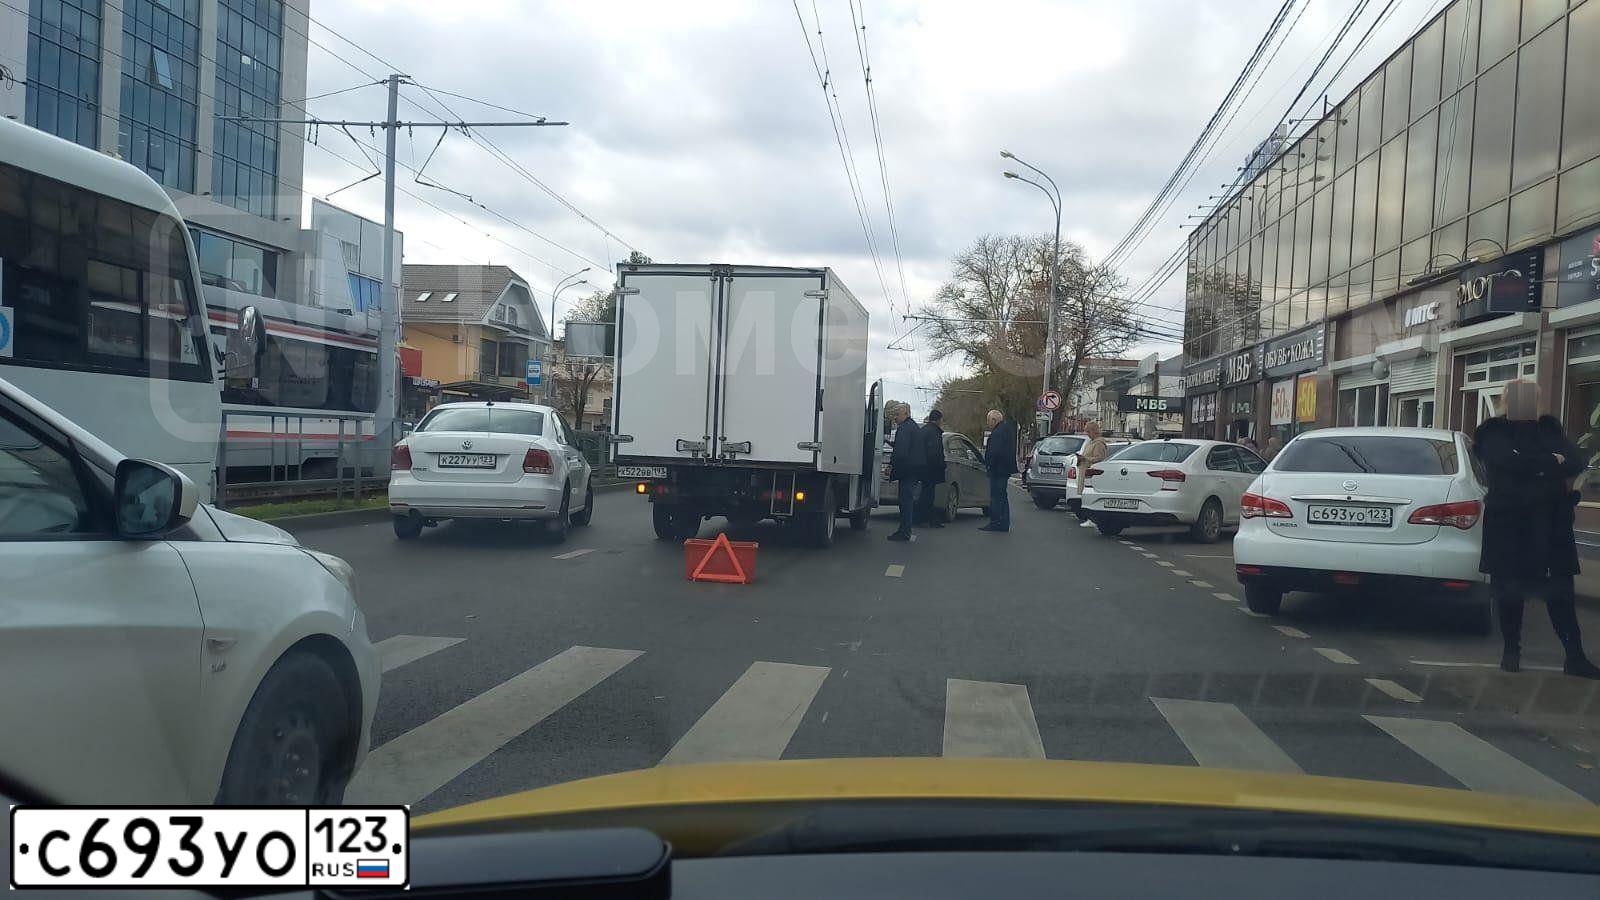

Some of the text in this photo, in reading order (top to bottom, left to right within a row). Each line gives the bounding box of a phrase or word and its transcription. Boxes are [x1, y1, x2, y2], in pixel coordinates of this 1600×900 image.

[1226, 353, 1250, 384] МВБ
[1136, 398, 1168, 411] МВБ
[1367, 509, 1388, 520] 123
